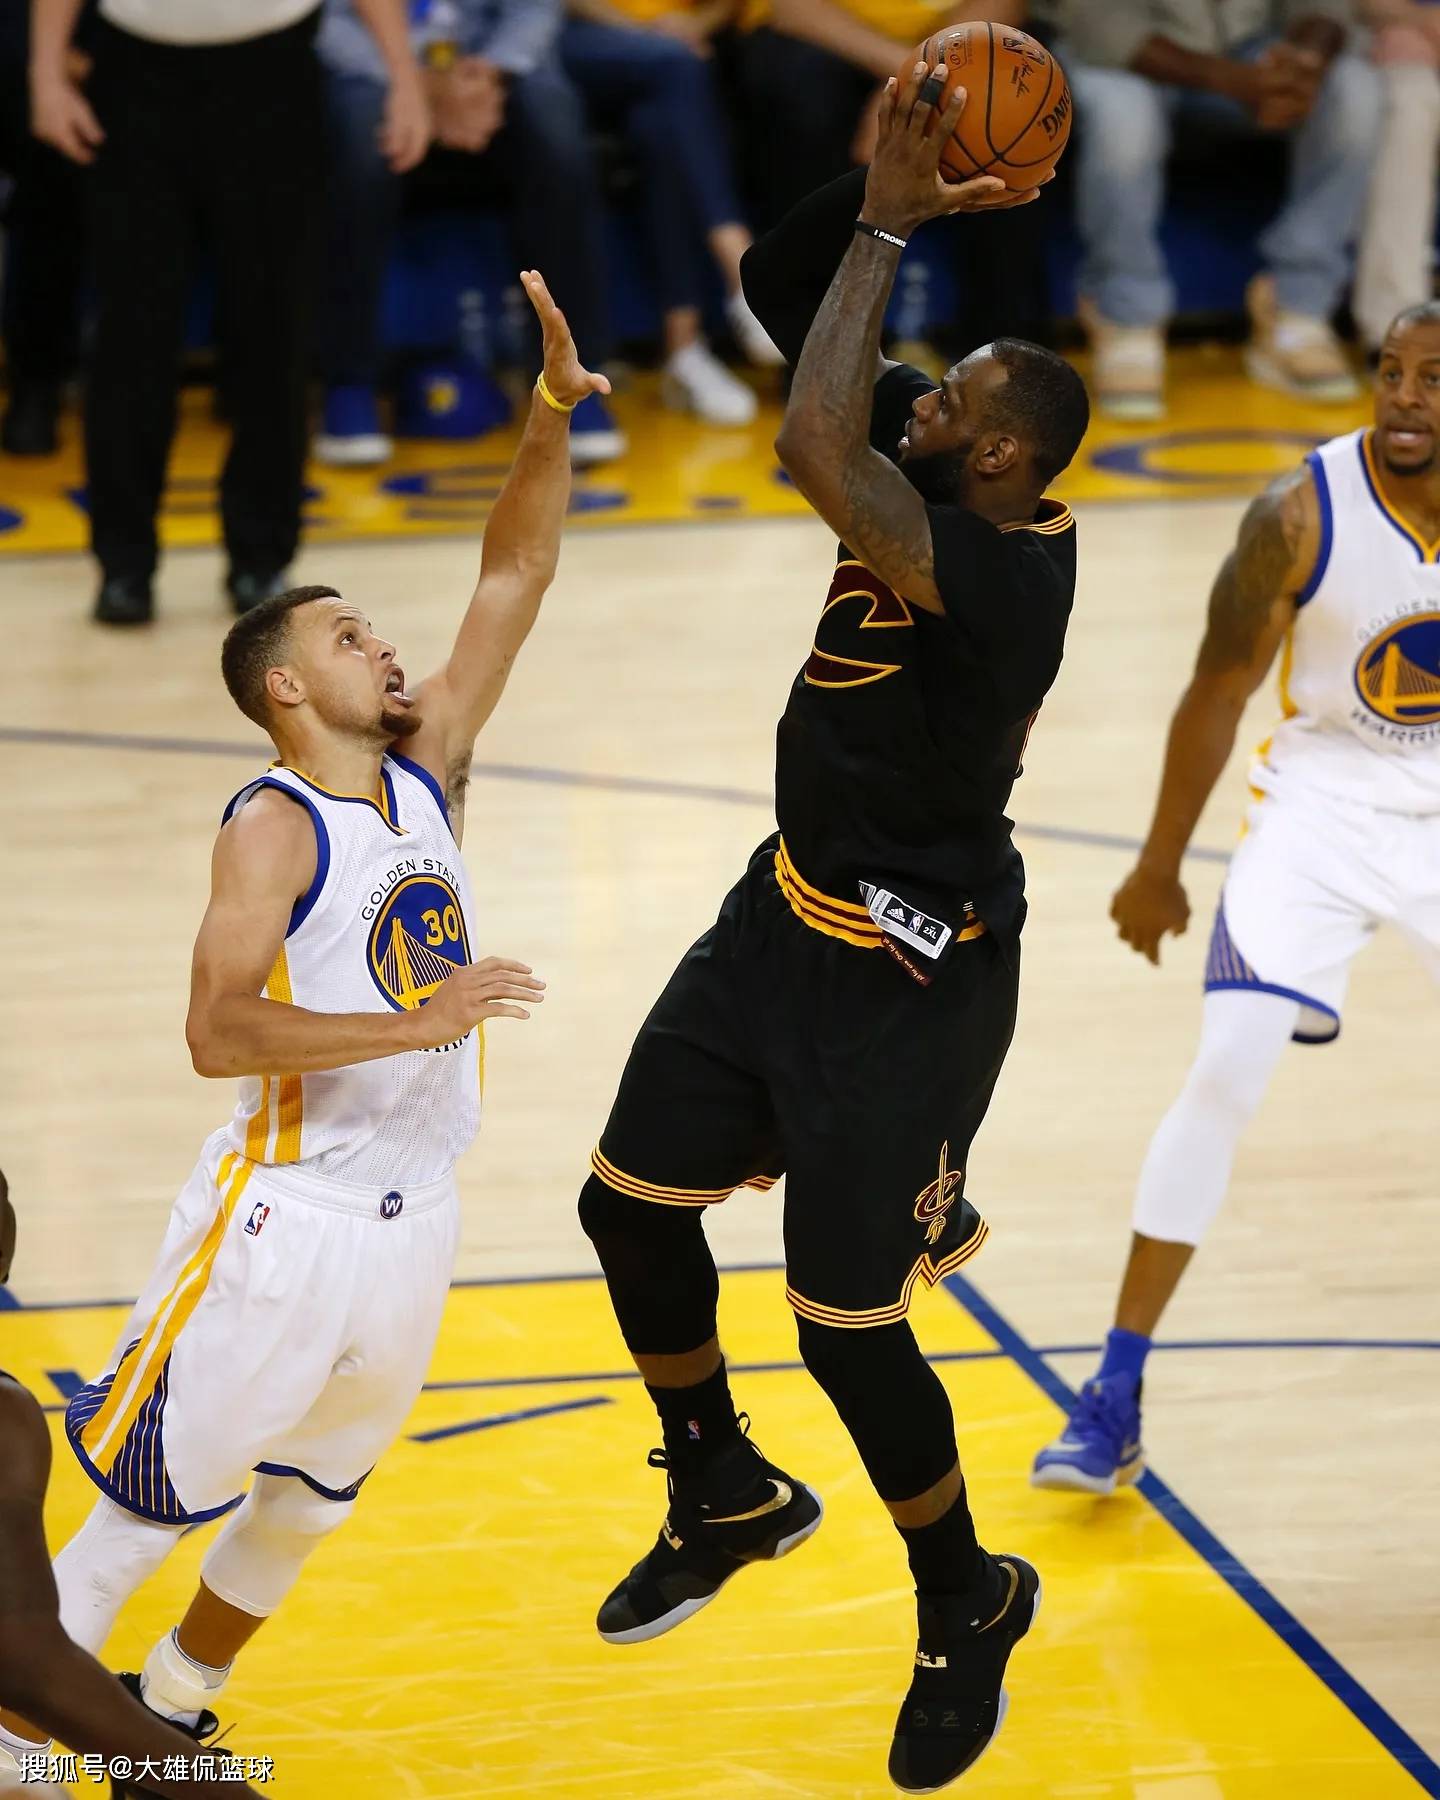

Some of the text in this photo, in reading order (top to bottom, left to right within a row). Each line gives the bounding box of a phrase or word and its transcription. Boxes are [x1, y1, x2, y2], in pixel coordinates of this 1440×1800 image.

[1351, 708, 1440, 744] WARRI
[361, 858, 462, 921] GOLDEN STATE
[420, 904, 460, 946] 30
[886, 909, 906, 923] adidas
[923, 926, 937, 940] 2XL
[383, 1199, 402, 1214] W
